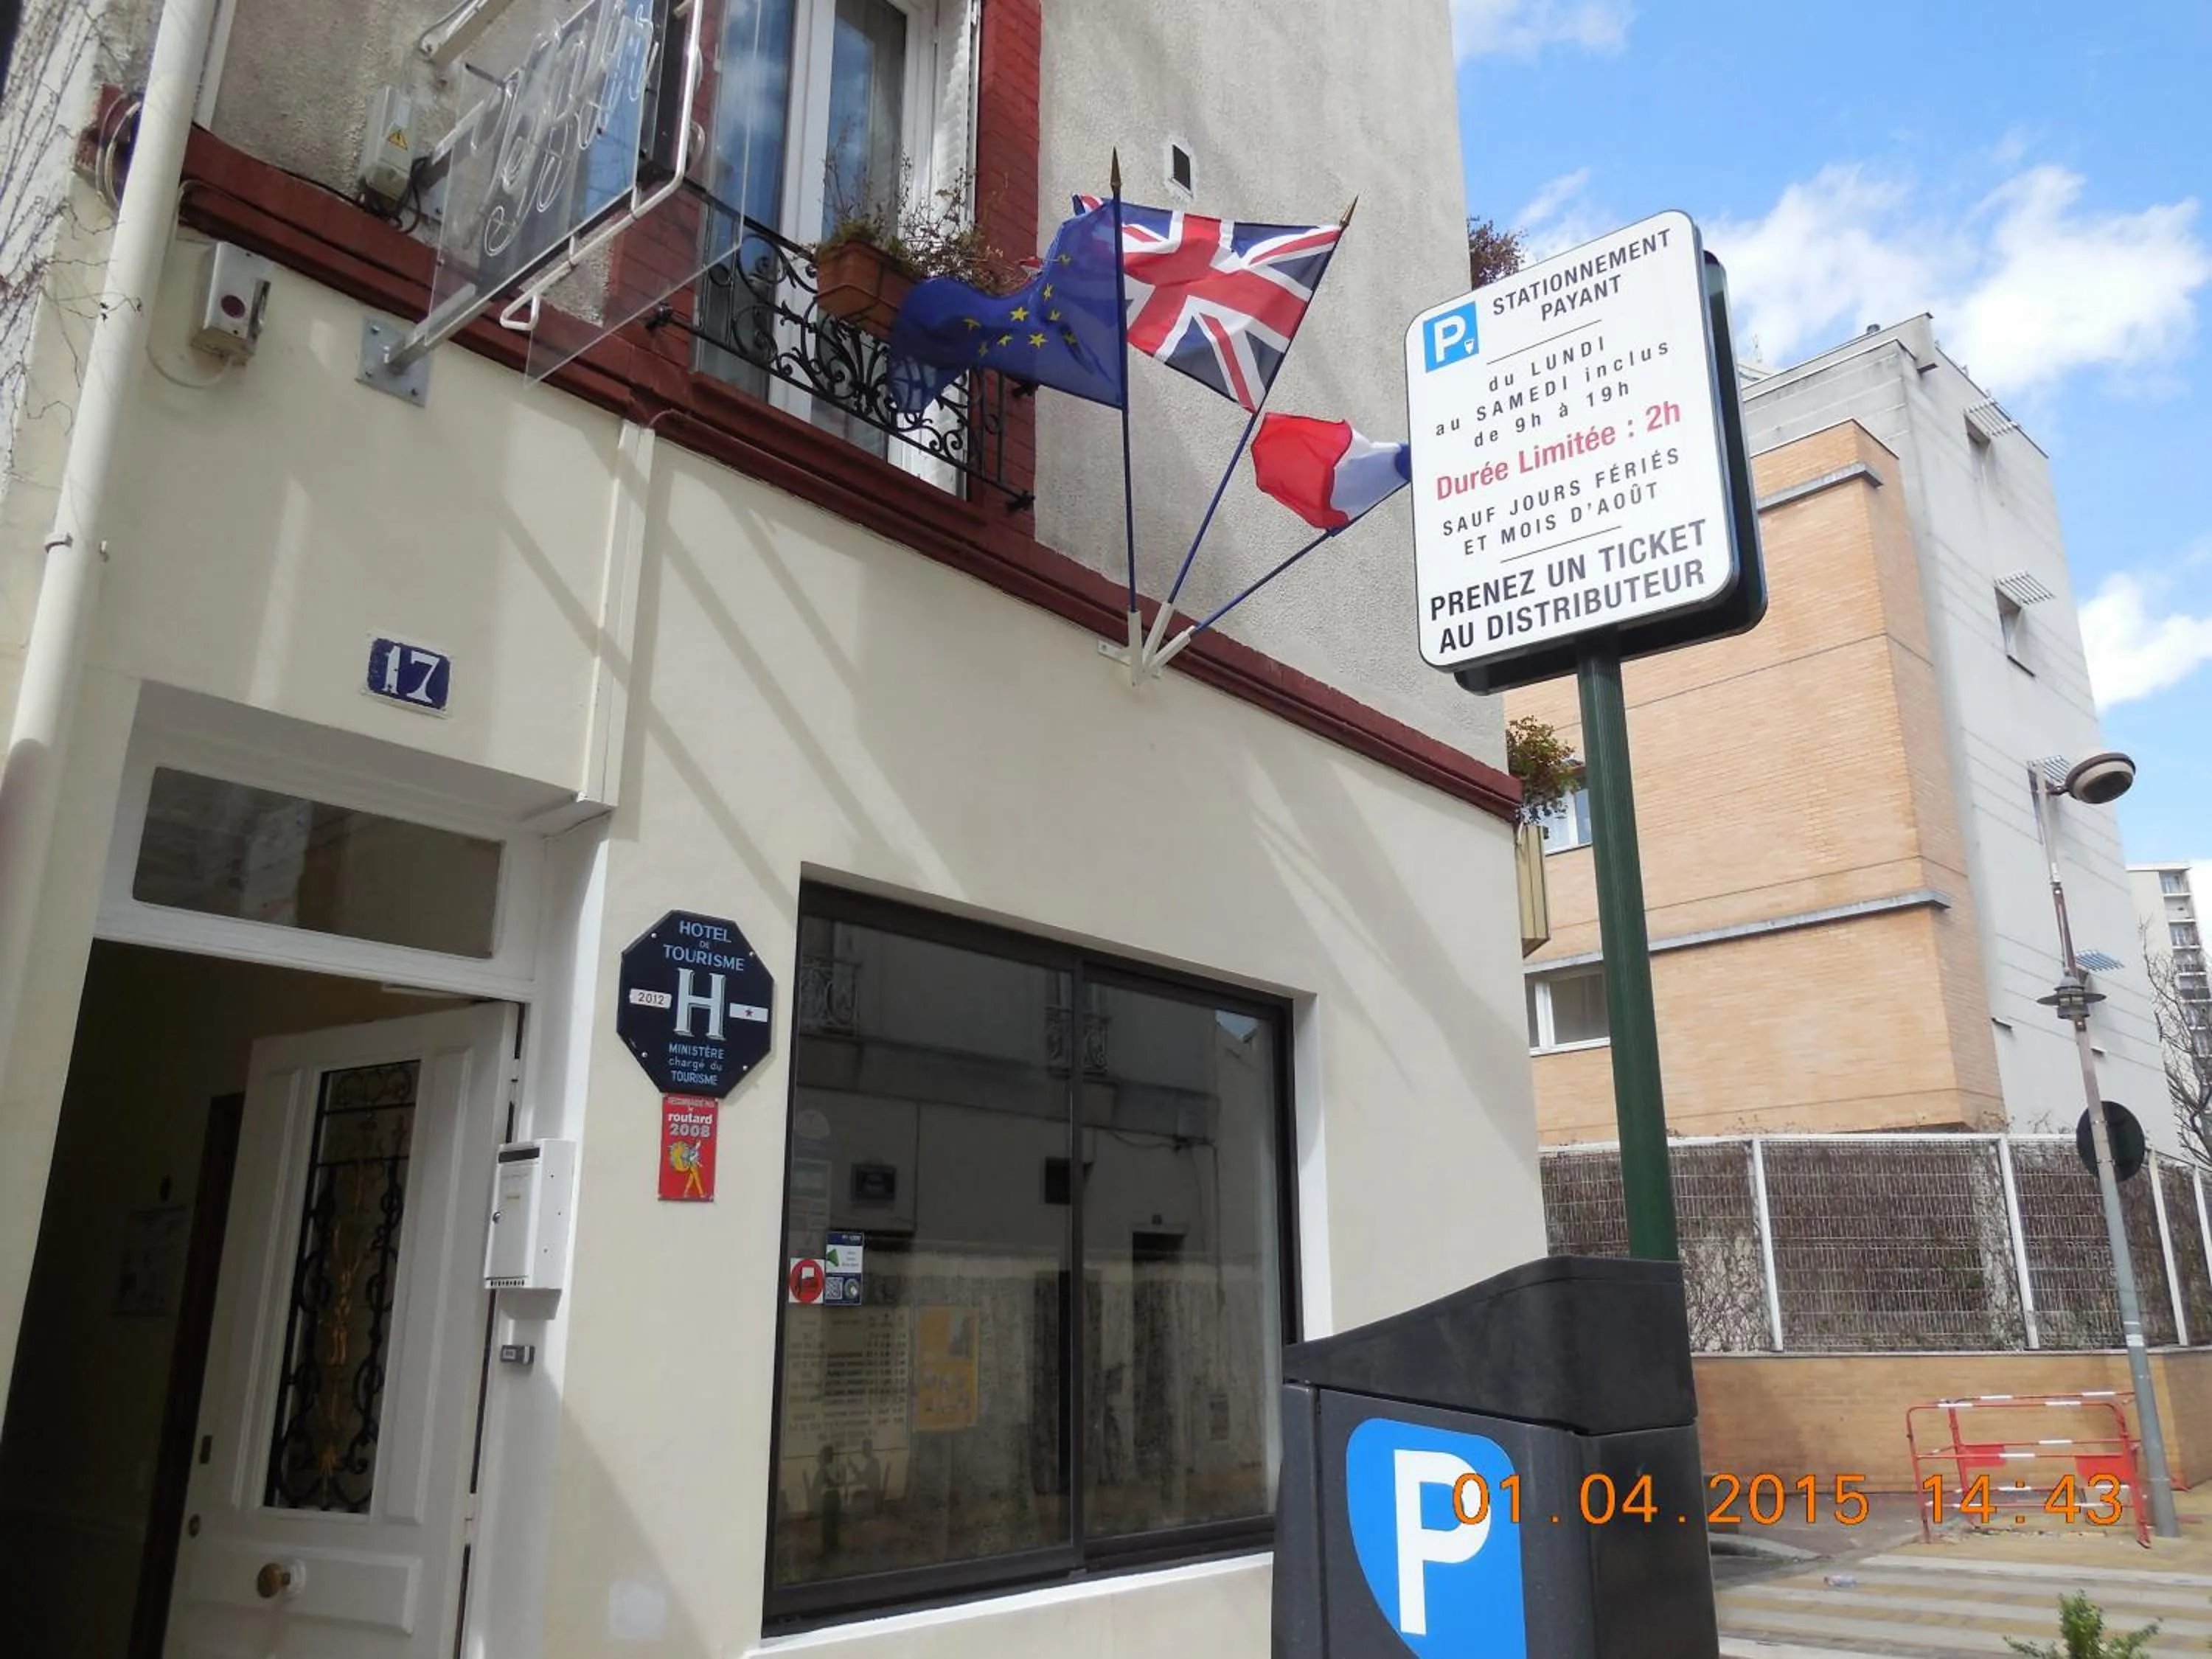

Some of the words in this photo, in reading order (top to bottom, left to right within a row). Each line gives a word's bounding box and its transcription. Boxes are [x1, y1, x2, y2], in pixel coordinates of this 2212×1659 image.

[1493, 229, 1670, 315] STATIONNEMENT
[1541, 274, 1621, 321] PAYANT
[1433, 315, 1467, 364] P
[1489, 374, 1514, 392] du
[1531, 336, 1603, 376] LUNDI
[1436, 418, 1459, 436] au
[1477, 376, 1567, 421] SAMEDI
[1586, 342, 1668, 382] inclus
[1475, 430, 1498, 447] de
[1515, 413, 1540, 433] 9h
[1559, 403, 1568, 417] à
[1587, 382, 1628, 407] 19h
[1438, 462, 1508, 500] Durée
[1519, 426, 1615, 473] Limitée
[1646, 401, 1680, 431] 2h
[1443, 507, 1495, 536] SAUF
[1510, 480, 1580, 515] JOURS
[1596, 448, 1678, 488] FÉRIÉS
[1464, 535, 1486, 555] ET
[1501, 515, 1556, 544] MOIS
[1571, 482, 1656, 523] D'AOÛT
[1430, 569, 1535, 621] PRENEZ
[1548, 554, 1585, 587] UN
[1599, 519, 1705, 572] TICKET
[1439, 622, 1474, 654] AU
[1487, 560, 1704, 641] DISTRIBUTEUR
[382, 645, 440, 703] 17
[663, 944, 745, 971] TOURISME
[679, 920, 732, 943] HOTEL
[638, 992, 664, 1006] 2012
[673, 967, 726, 1042] H
[668, 1056, 705, 1071] chargé
[710, 1061, 723, 1071] du
[670, 1070, 718, 1086] TOURISME
[667, 1112, 713, 1125] routard
[669, 1123, 711, 1138] 2008
[1394, 1449, 1492, 1635] P
